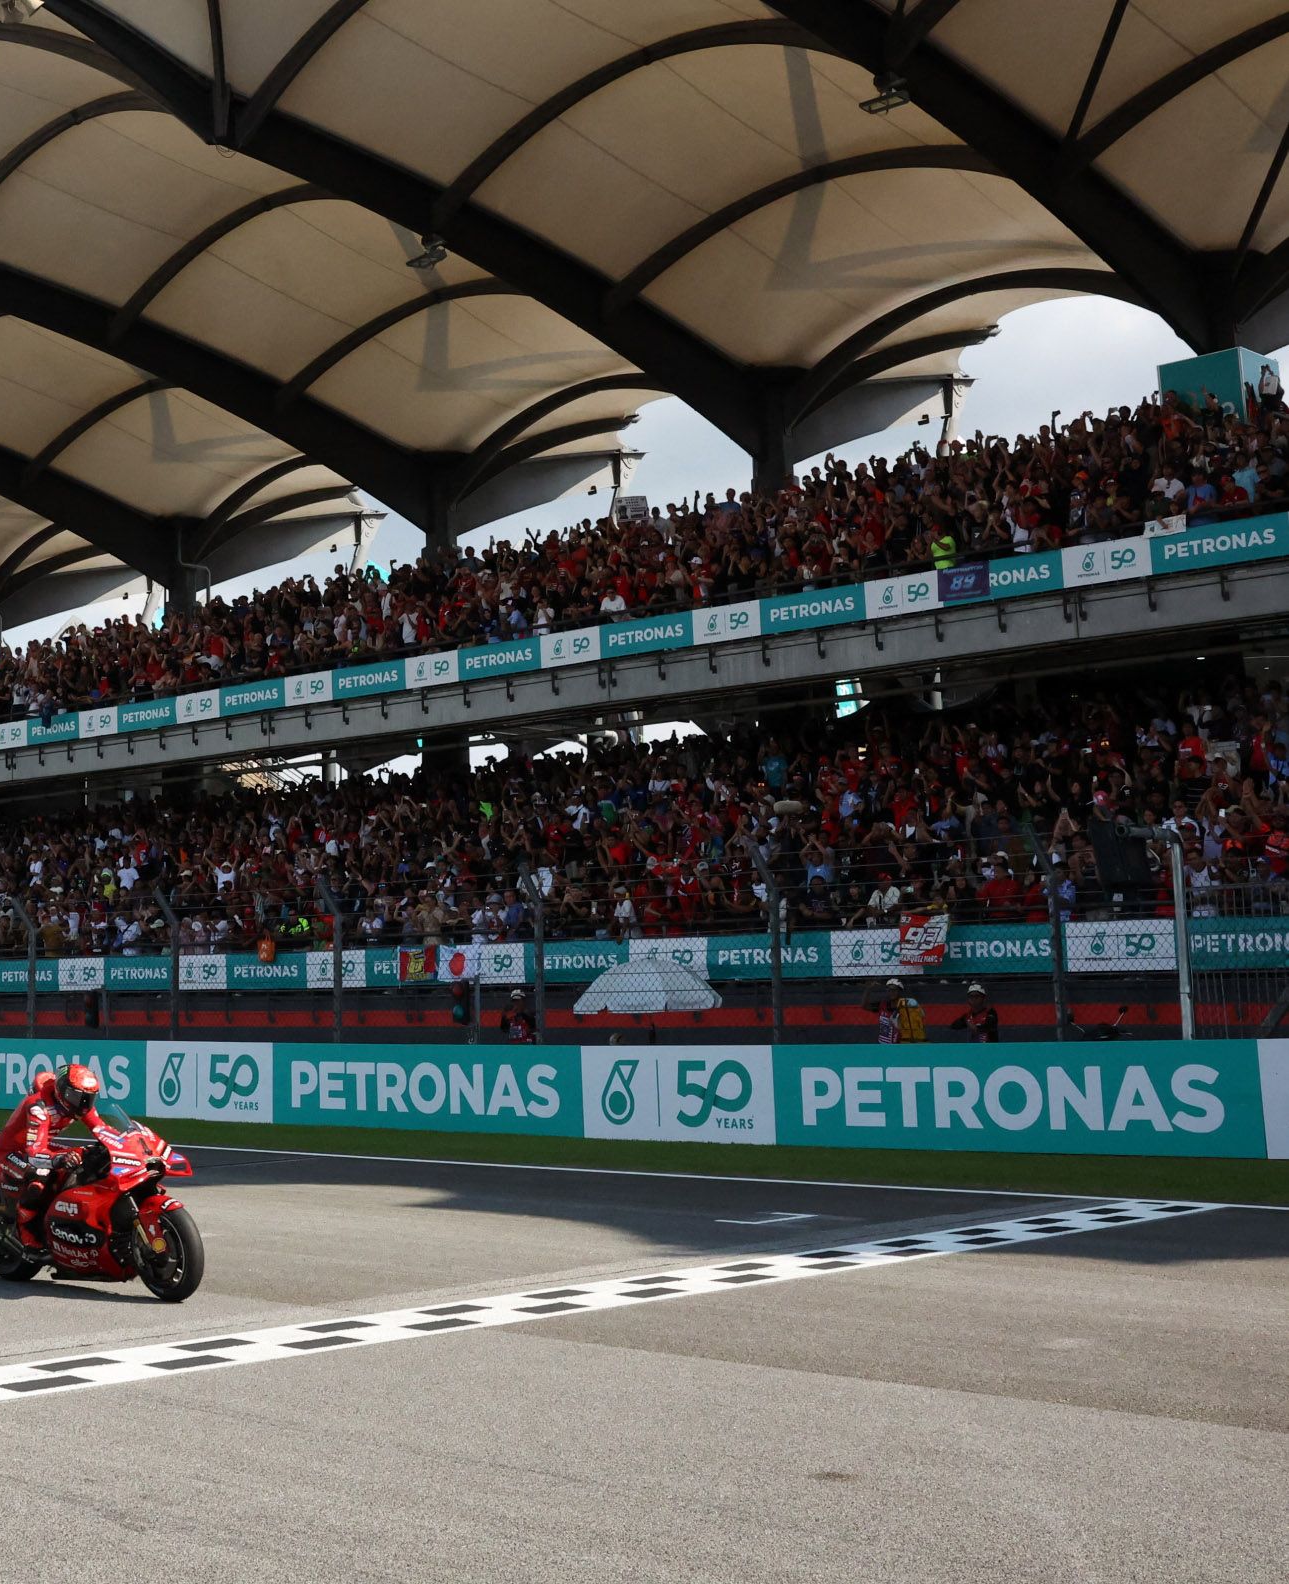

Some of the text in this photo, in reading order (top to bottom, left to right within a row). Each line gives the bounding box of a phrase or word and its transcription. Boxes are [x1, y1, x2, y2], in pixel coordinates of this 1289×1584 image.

[1164, 528, 1276, 559] PETRONAS
[1111, 548, 1135, 569] 50
[989, 564, 1050, 587] RONAS
[907, 583, 929, 602] 50
[770, 597, 854, 622] PETRONAS
[730, 612, 749, 630] 50
[609, 624, 684, 647] PETRONAS
[573, 637, 590, 655] 50
[466, 648, 532, 669] PETRONAS
[434, 660, 449, 677] 50
[310, 680, 324, 695] 50
[338, 669, 398, 690] PETRONAS
[200, 698, 212, 712] 50
[224, 688, 278, 706] PETRONAS
[100, 714, 111, 728] 50
[122, 707, 170, 724] PETRONAS
[11, 727, 21, 741] 50
[900, 926, 941, 950] 93
[1126, 934, 1155, 957] 50
[945, 938, 1051, 958] ETRONAS
[493, 954, 512, 972] 50
[535, 954, 617, 969] ETRONAS
[2, 970, 52, 983] PETRNAS
[111, 967, 167, 980] PETRONAS
[202, 964, 217, 979] 50
[233, 964, 298, 978] PETRONAS
[208, 1054, 259, 1109] 50
[291, 1060, 560, 1118] PETRONAS
[677, 1060, 753, 1128] 50
[801, 1064, 1225, 1133] PETRONAS
[234, 1101, 259, 1110] YEARS
[716, 1118, 753, 1129] YEARS
[7, 1153, 27, 1169] Lenovo
[113, 1156, 141, 1166] Lenovo
